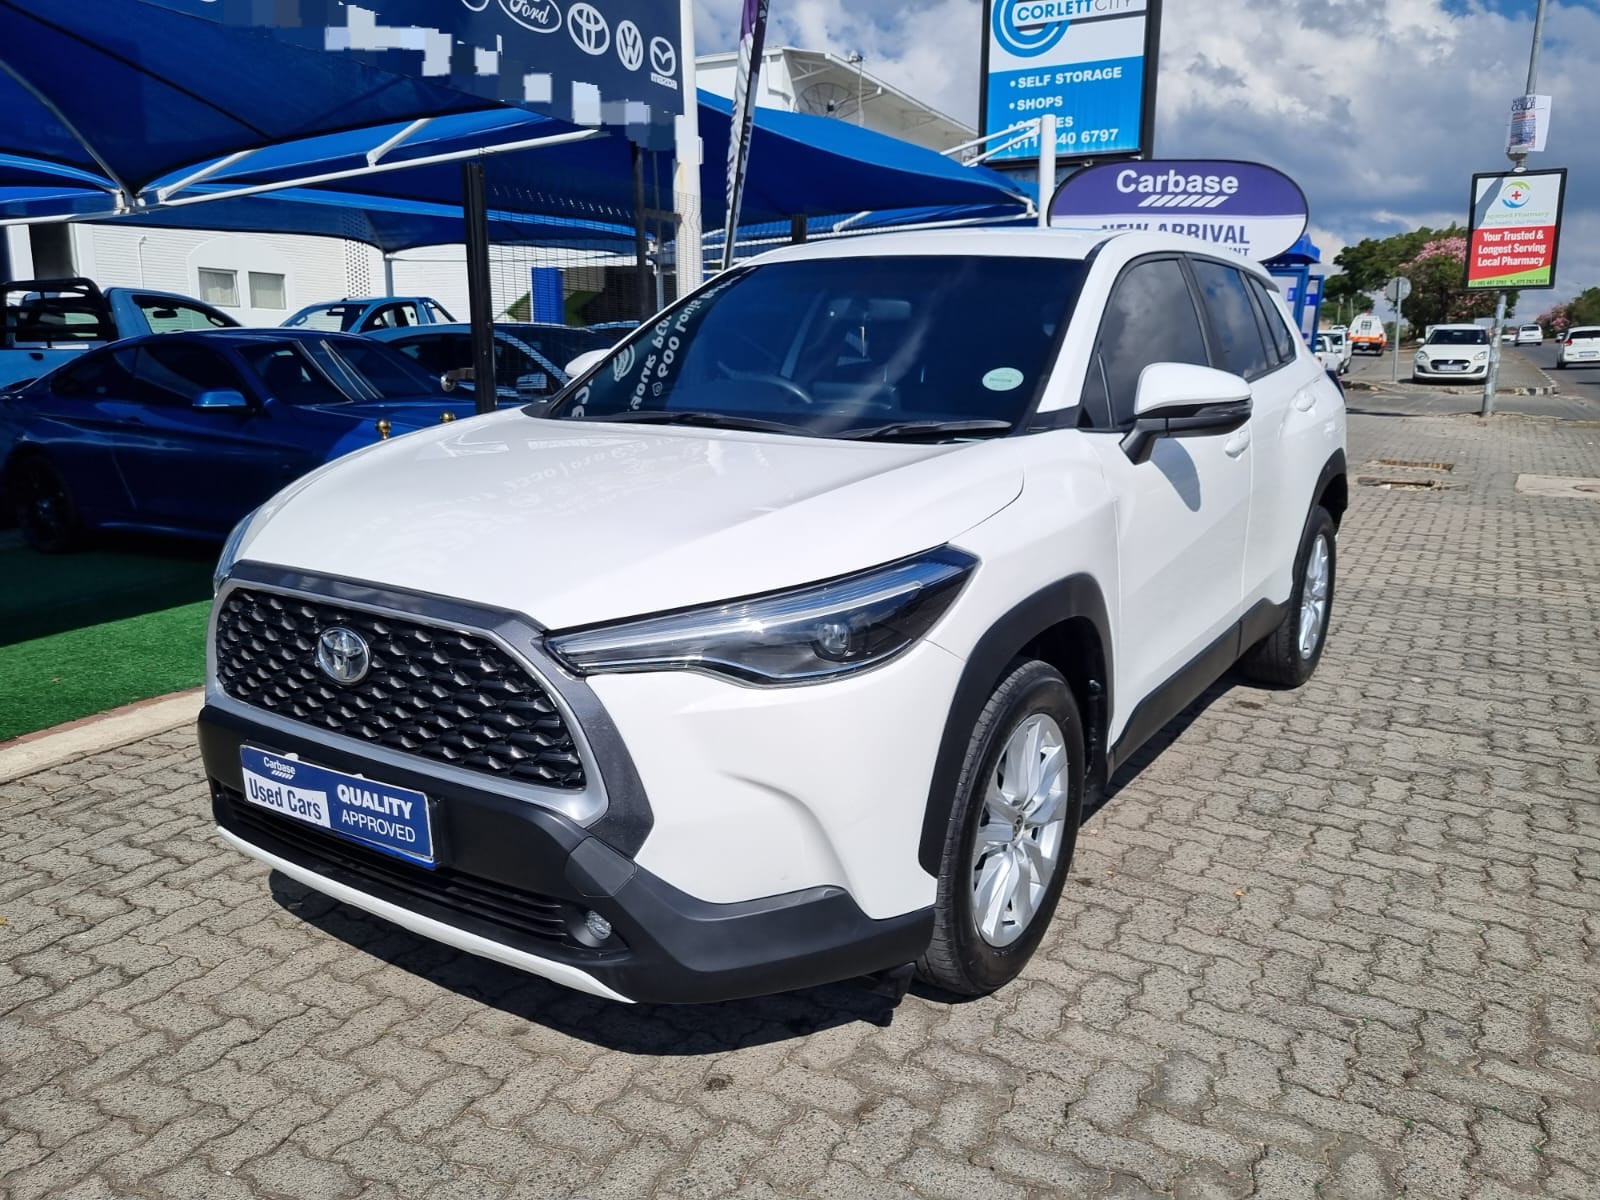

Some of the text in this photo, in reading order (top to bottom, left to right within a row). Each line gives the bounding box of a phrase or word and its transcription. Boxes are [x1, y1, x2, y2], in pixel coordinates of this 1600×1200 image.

[1018, 66, 1122, 89] SELF STORAGE
[1016, 95, 1063, 111] SHOPS
[1081, 128, 1119, 143] 6797
[1116, 169, 1239, 194] Carbase
[1483, 229, 1544, 242] Your Trusted &
[1478, 242, 1546, 256] Longest Serving
[1477, 256, 1545, 267] Local Pharmacy
[263, 756, 296, 775] Carbase
[249, 777, 322, 820] Used Cars
[336, 783, 413, 820] QUALITY
[341, 809, 416, 843] APPROVED
